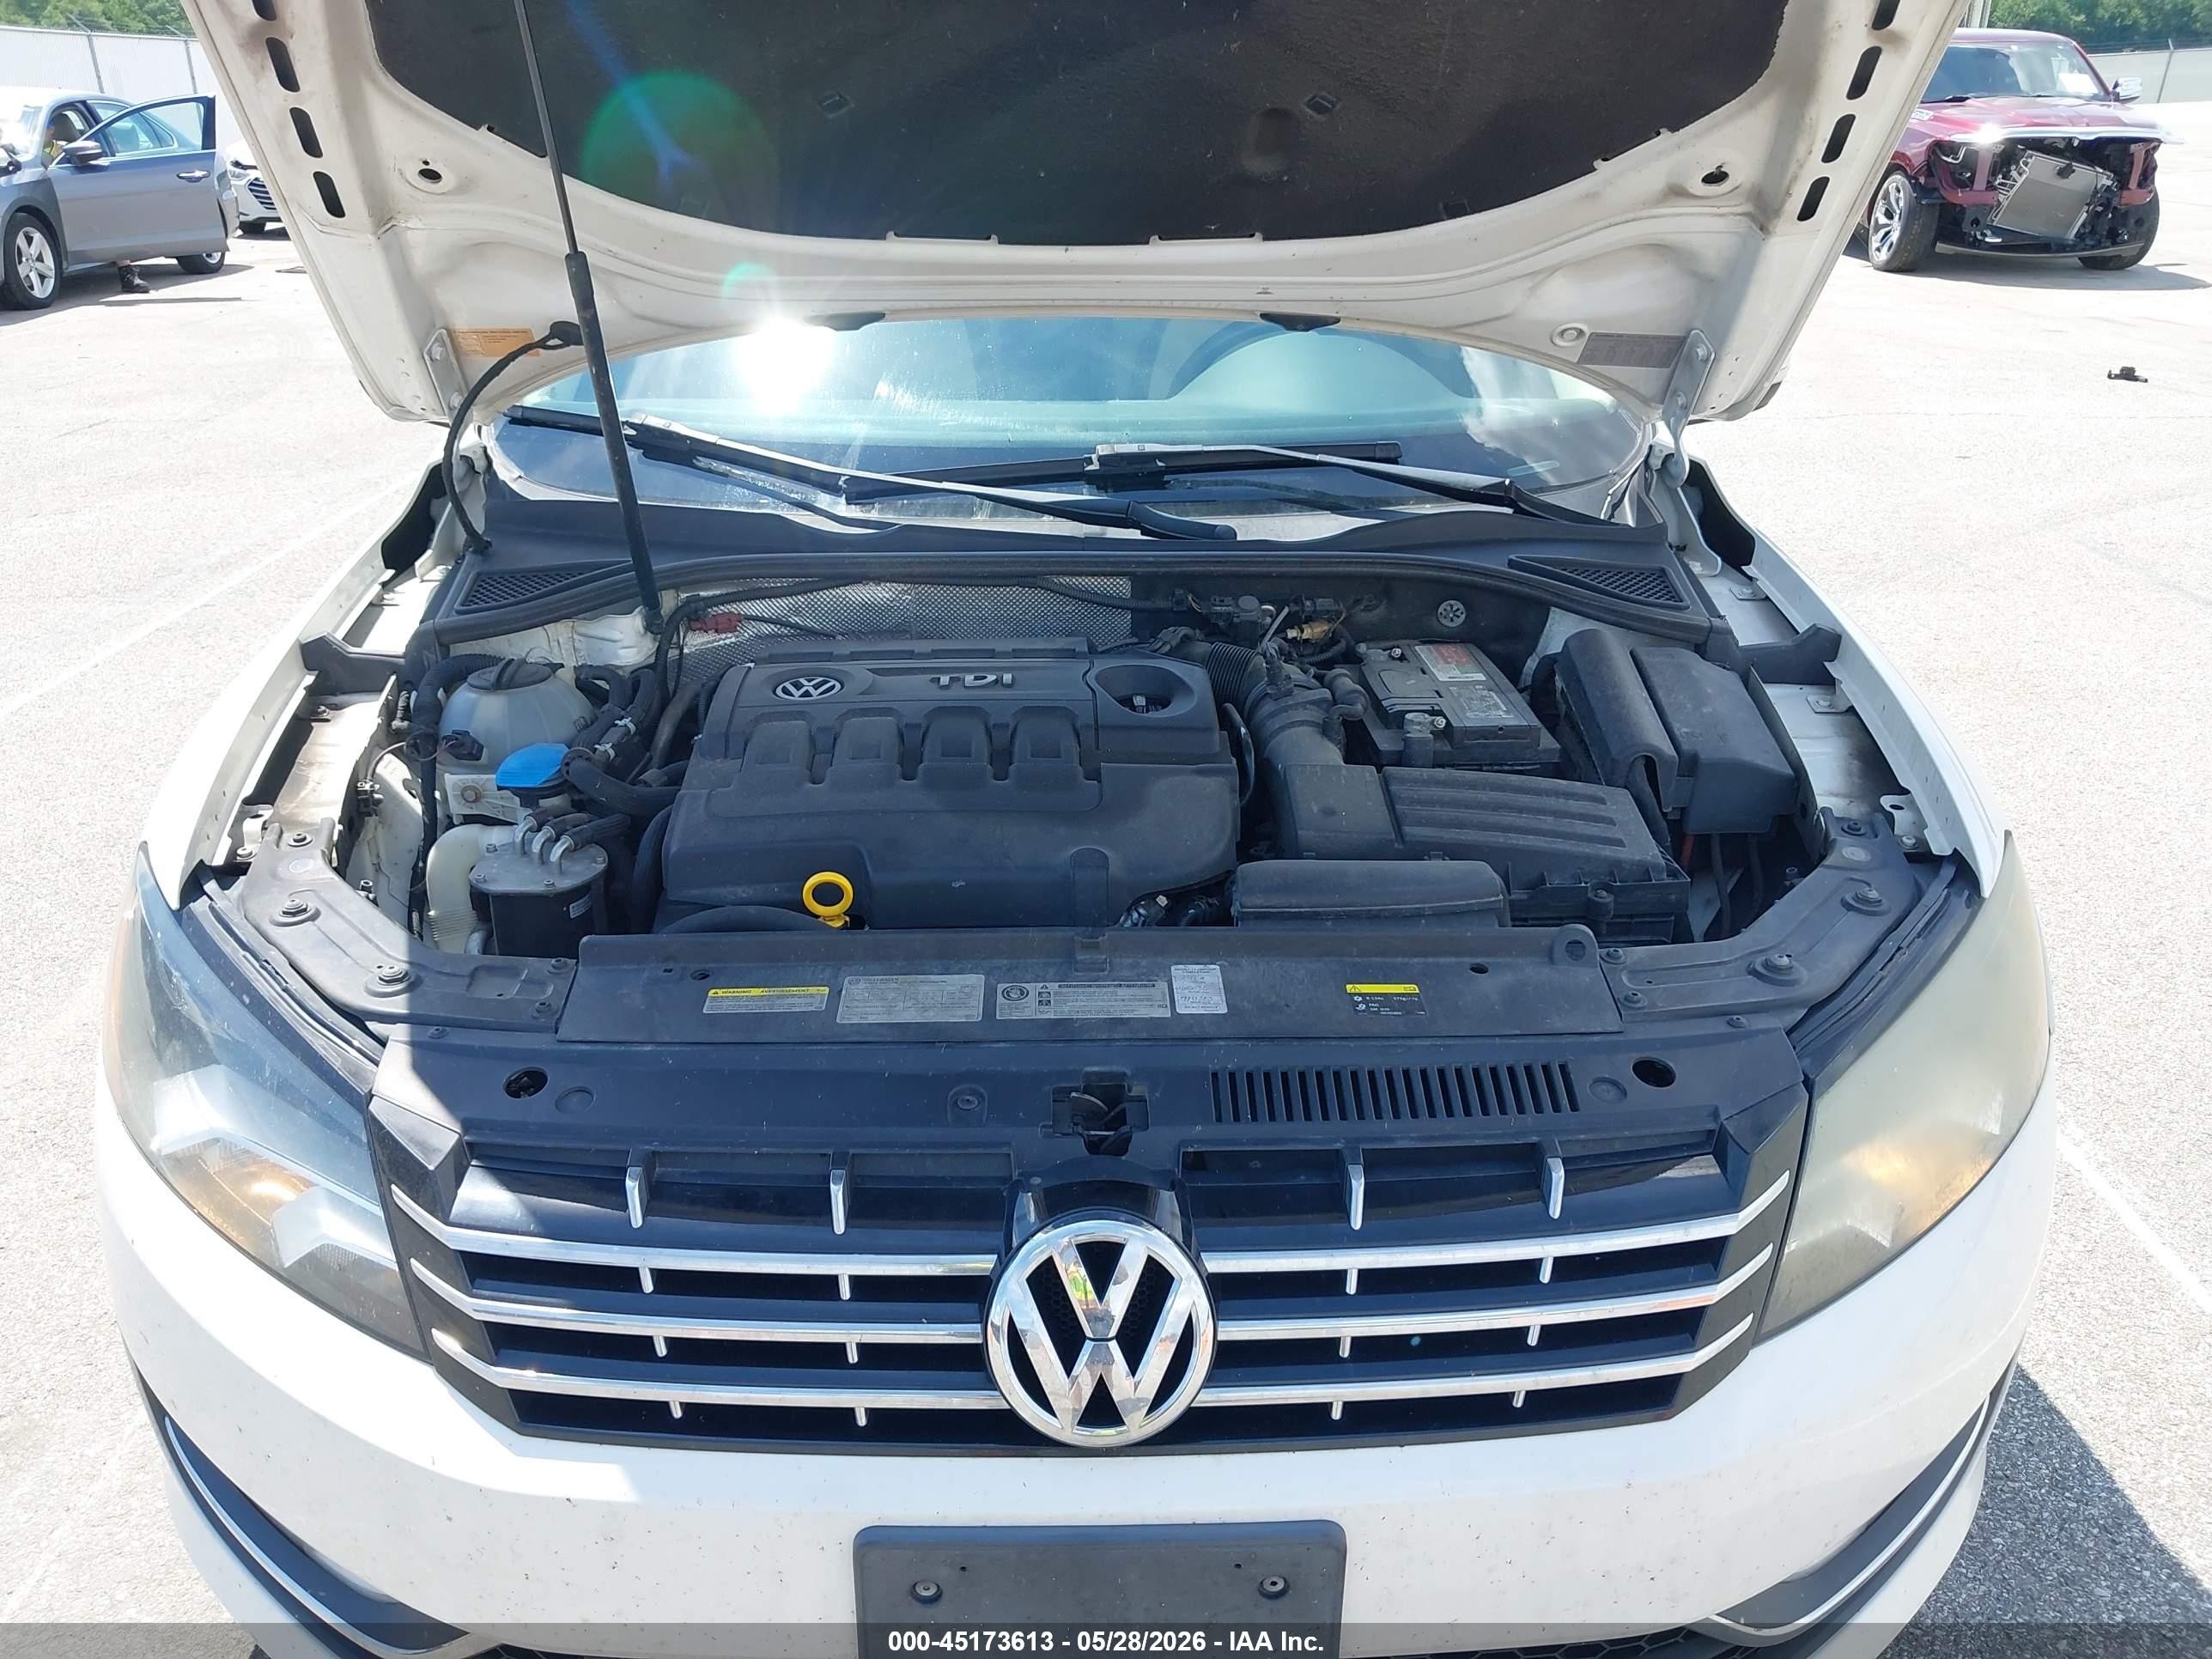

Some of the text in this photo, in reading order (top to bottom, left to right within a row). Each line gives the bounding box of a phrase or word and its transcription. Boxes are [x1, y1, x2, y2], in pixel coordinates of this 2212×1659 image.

[775, 677, 842, 701] VW
[931, 672, 1014, 688] TDI
[988, 1219, 1214, 1447] VW
